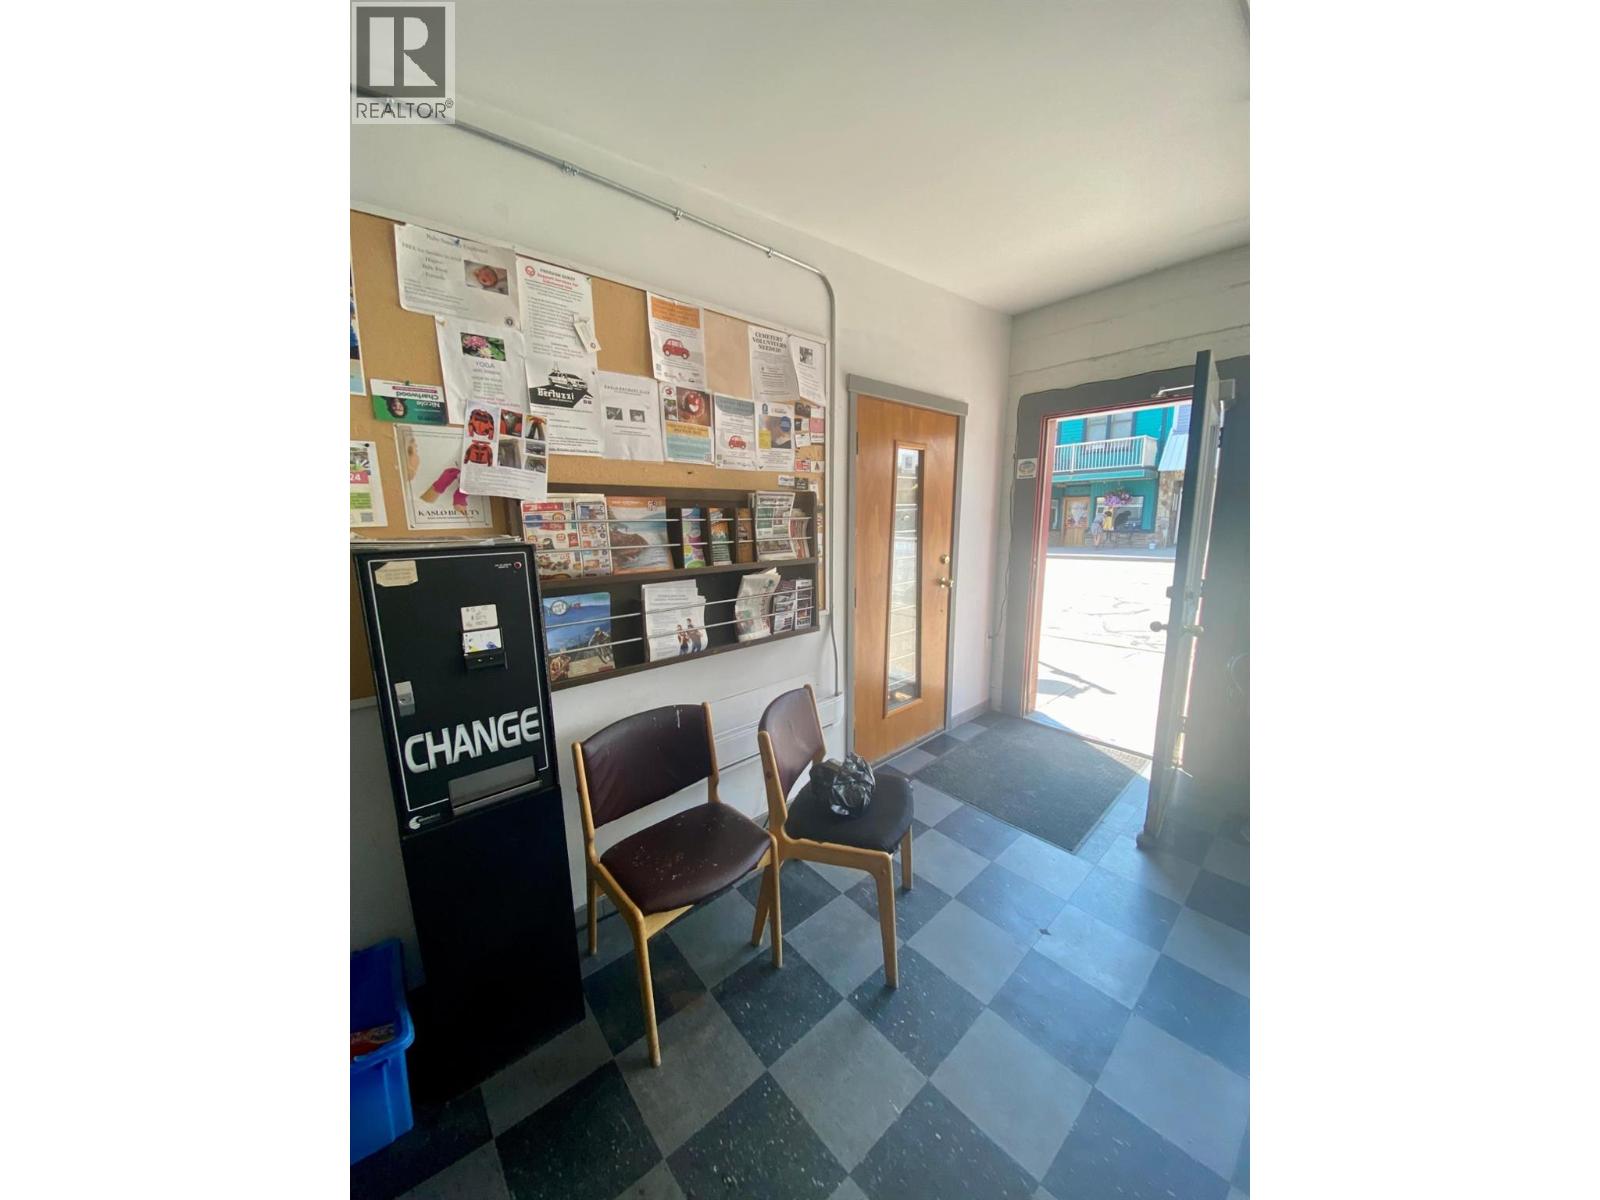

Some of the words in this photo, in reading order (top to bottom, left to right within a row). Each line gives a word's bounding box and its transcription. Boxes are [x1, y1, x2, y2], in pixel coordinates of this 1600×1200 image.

[752, 336, 787, 349] VOLUNTEERS
[755, 331, 784, 343] CEMETERY
[537, 387, 575, 401] Bertuzzi
[404, 706, 541, 774] CHANGE
